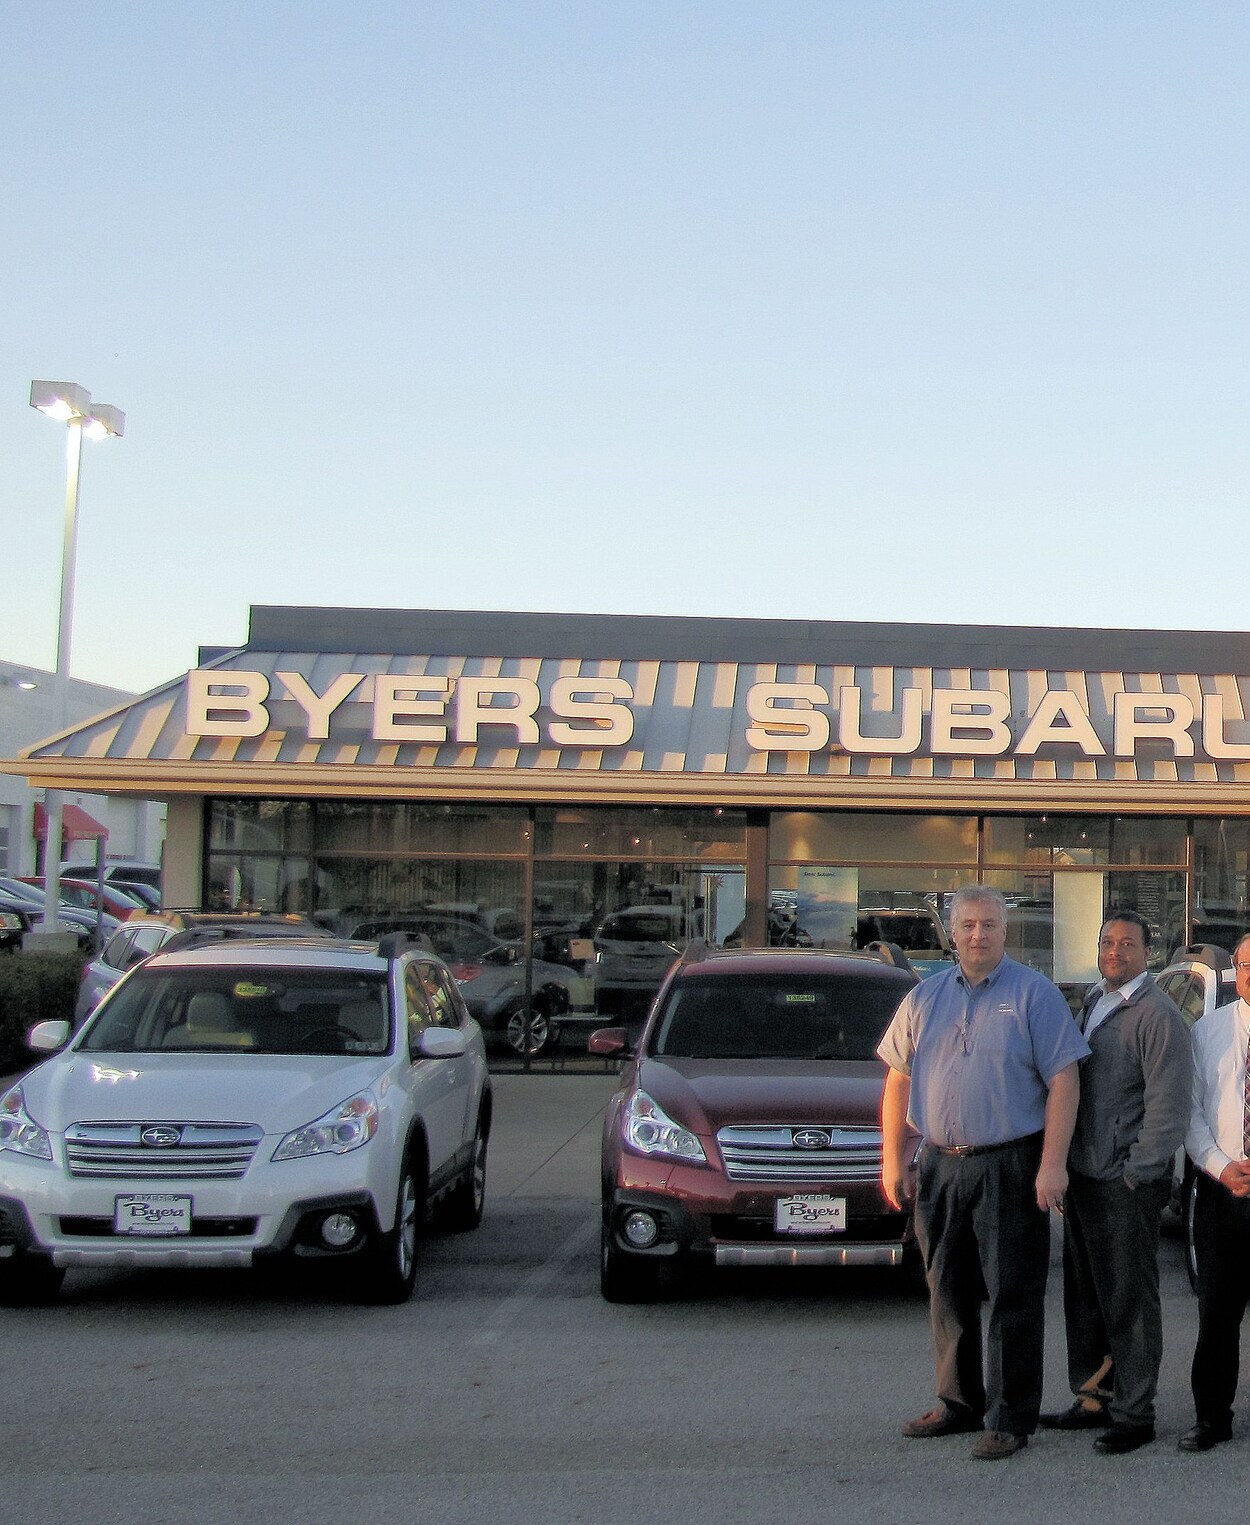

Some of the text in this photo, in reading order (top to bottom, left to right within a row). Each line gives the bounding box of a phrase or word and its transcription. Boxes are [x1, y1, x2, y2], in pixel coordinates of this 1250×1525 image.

[187, 668, 635, 746] BYERS
[123, 1202, 185, 1222] Byers
[782, 1202, 841, 1221] Byers
